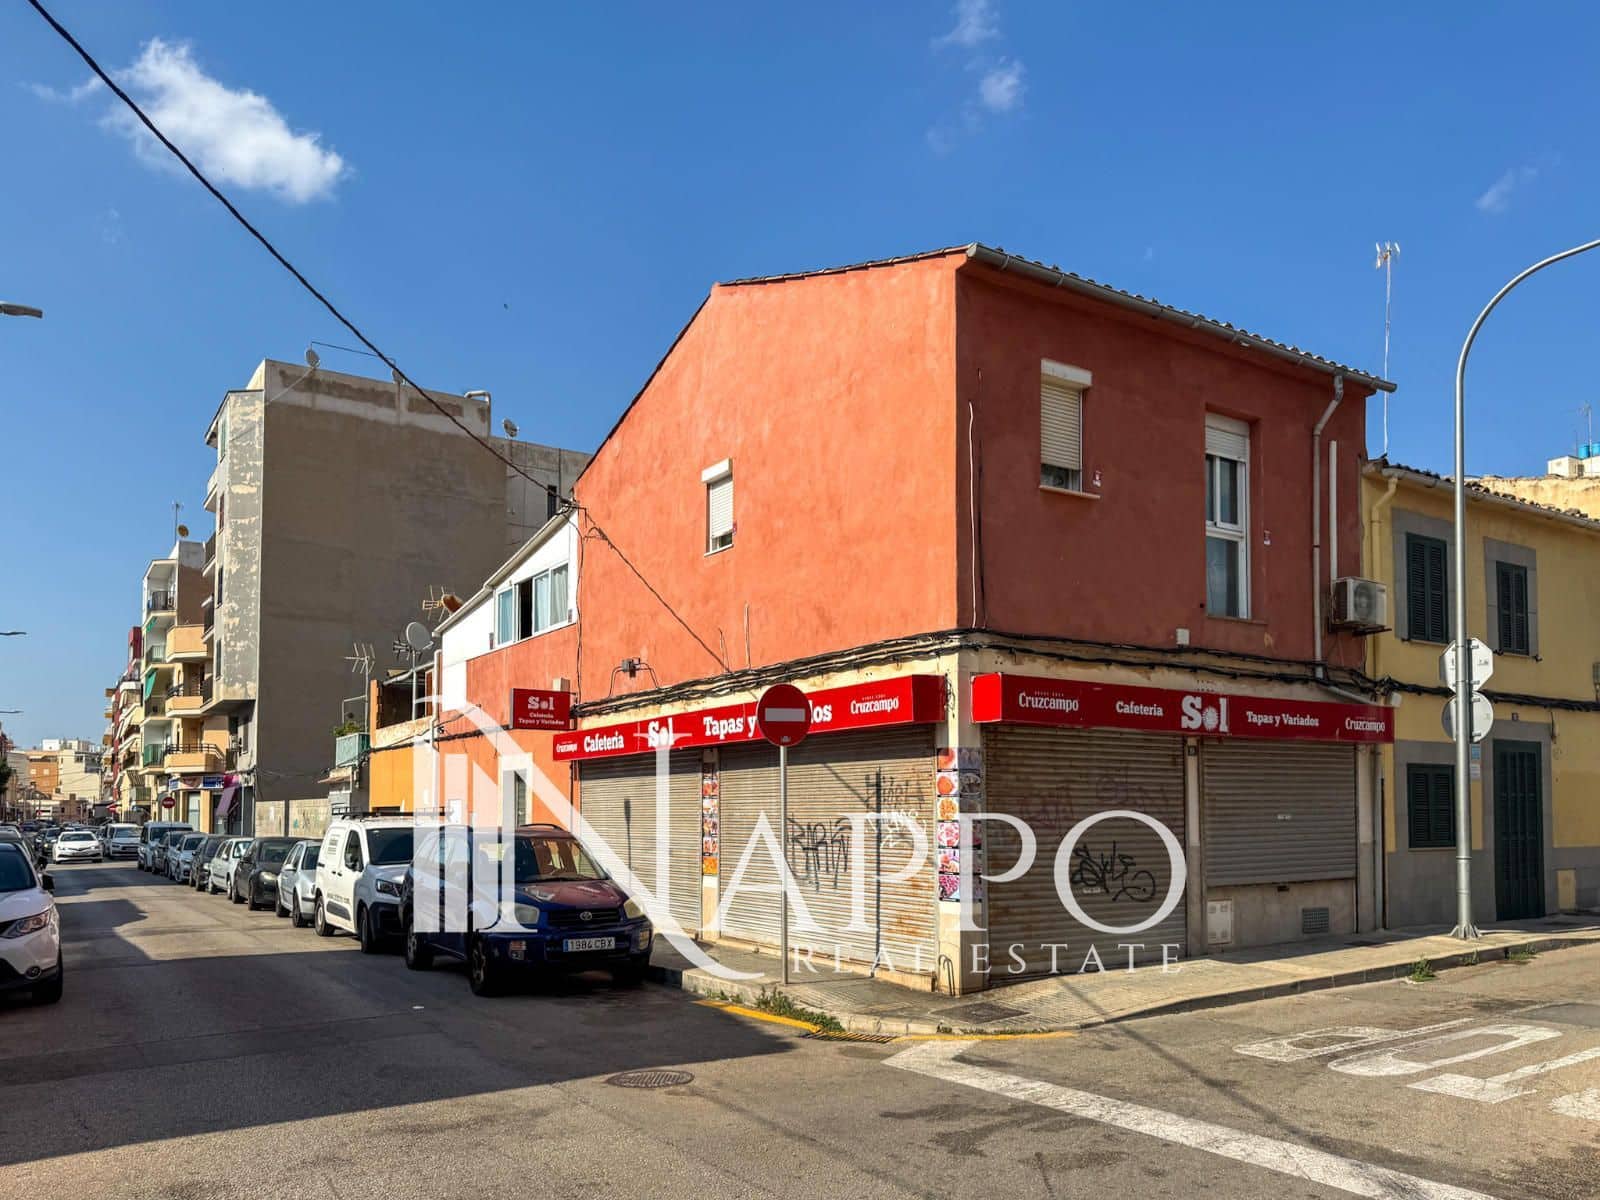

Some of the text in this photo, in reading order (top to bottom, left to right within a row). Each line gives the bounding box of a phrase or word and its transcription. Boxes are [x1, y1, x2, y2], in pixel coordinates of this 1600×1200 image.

[528, 695, 555, 710] Sol
[851, 697, 899, 714] Cruzcampo
[1019, 691, 1079, 712] Cruzcampo
[1116, 701, 1163, 716] Cafeteria
[1181, 695, 1230, 733] Sol
[1246, 711, 1319, 727] Tapas y Variados
[648, 717, 675, 748] Sol
[703, 715, 757, 739] Tapas y
[1345, 718, 1385, 732] Cruzcampo
